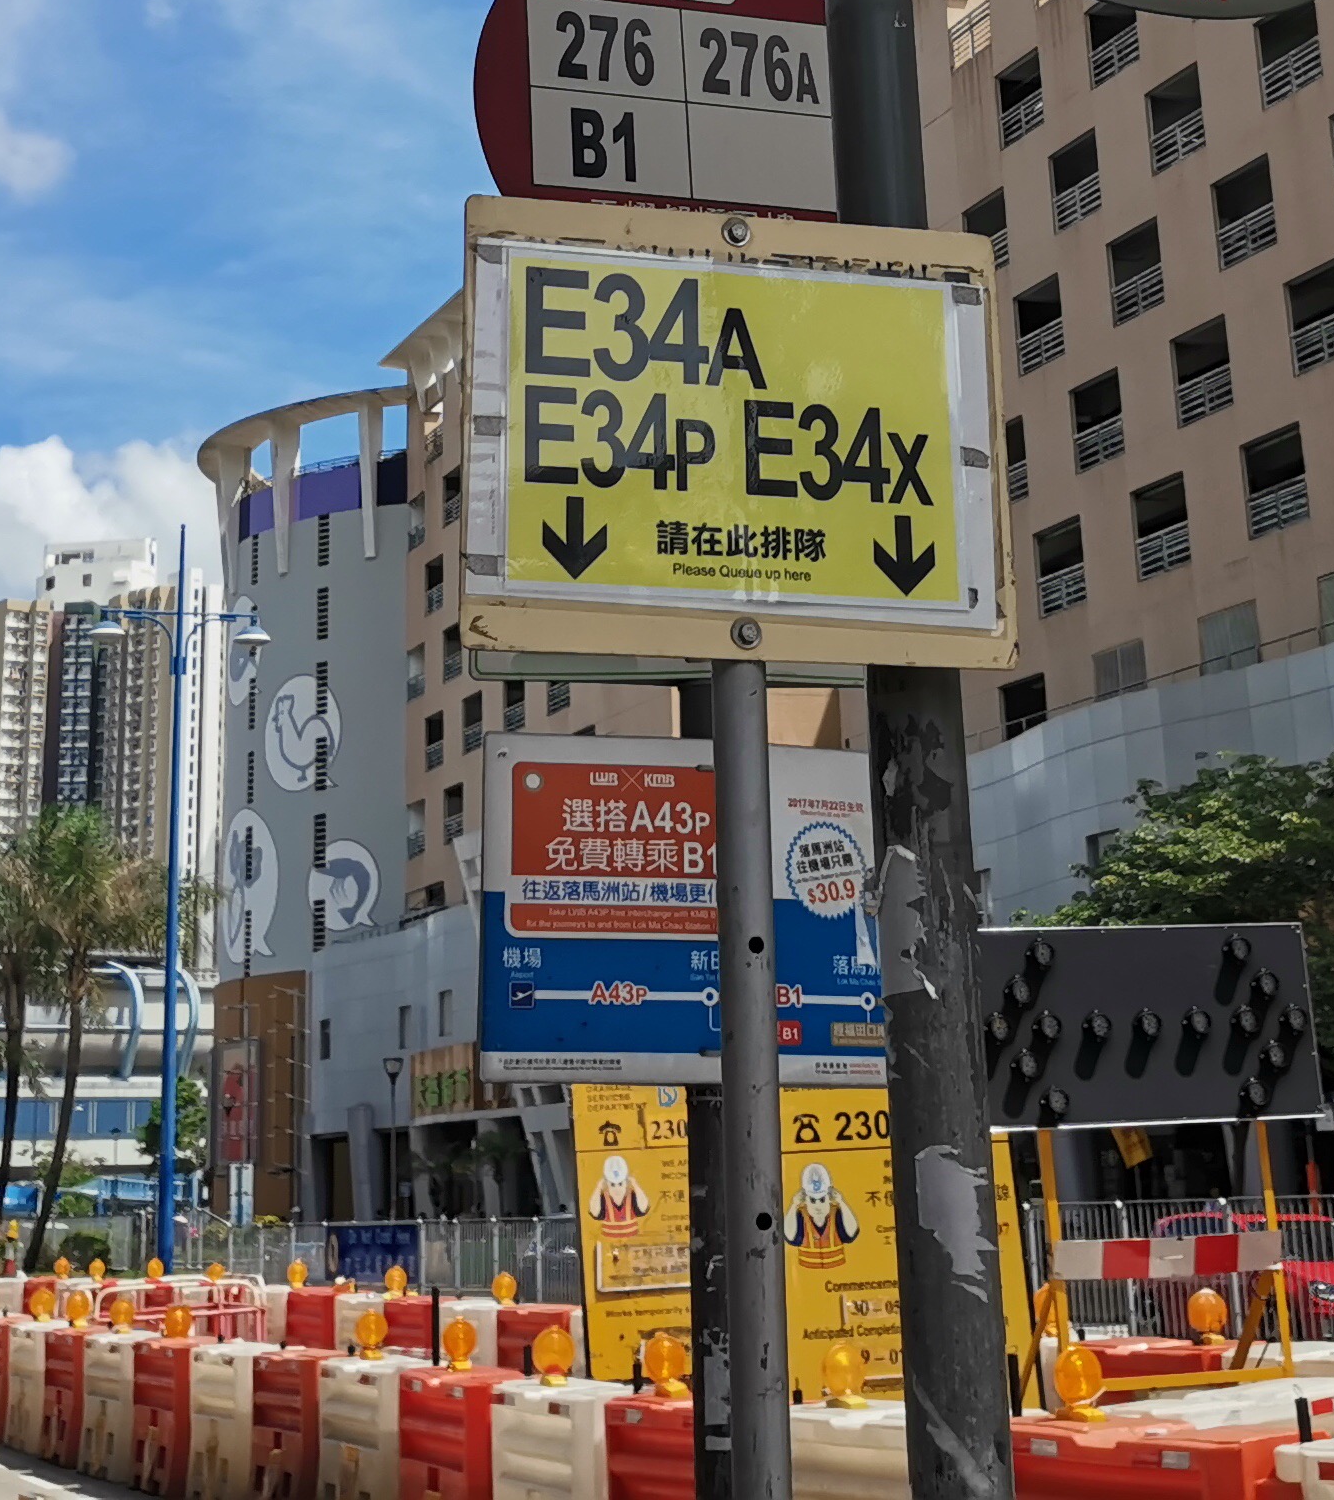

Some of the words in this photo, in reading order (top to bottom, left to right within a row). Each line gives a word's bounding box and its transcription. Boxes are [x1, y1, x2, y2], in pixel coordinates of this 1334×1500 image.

[556, 11, 655, 87] 276
[700, 27, 820, 105] 276A
[570, 107, 637, 184] B1
[524, 265, 767, 390] E34A
[524, 385, 716, 492] E34P
[744, 399, 935, 507] E34X
[656, 519, 826, 563] 請在此排隊
[673, 560, 717, 579] Please
[765, 570, 780, 584] up
[784, 567, 812, 583] here
[590, 771, 619, 786] LWB
[643, 772, 675, 788] KMB
[807, 878, 855, 905] $30.9
[502, 946, 542, 969] 機場
[588, 981, 649, 1006] A43P
[776, 984, 802, 1007] B1
[782, 1027, 798, 1040] B1
[651, 1119, 688, 1141] 230
[834, 1110, 890, 1142] 230
